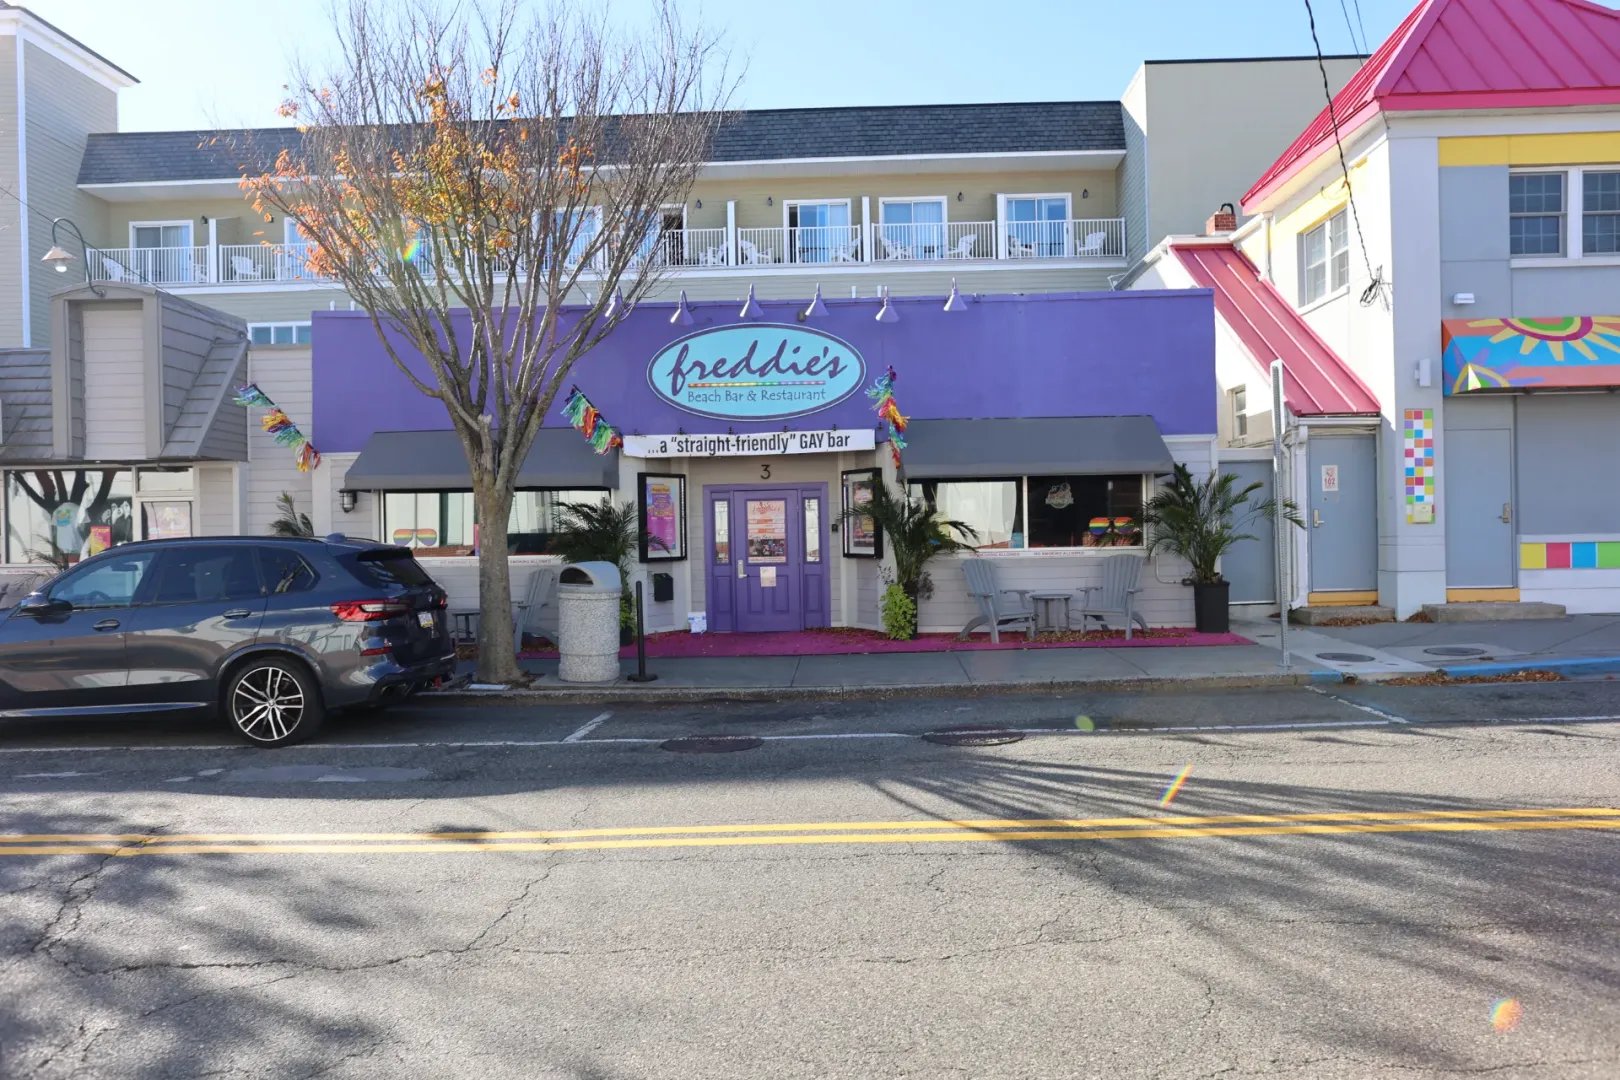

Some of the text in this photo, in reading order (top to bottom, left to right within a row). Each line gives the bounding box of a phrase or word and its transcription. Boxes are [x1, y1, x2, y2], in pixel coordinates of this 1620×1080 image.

[666, 338, 848, 396] freddie's
[687, 388, 827, 403] Beach Bar & Restaurant
[800, 432, 824, 449] GAY
[827, 431, 851, 448] bar
[760, 464, 771, 480] 3
